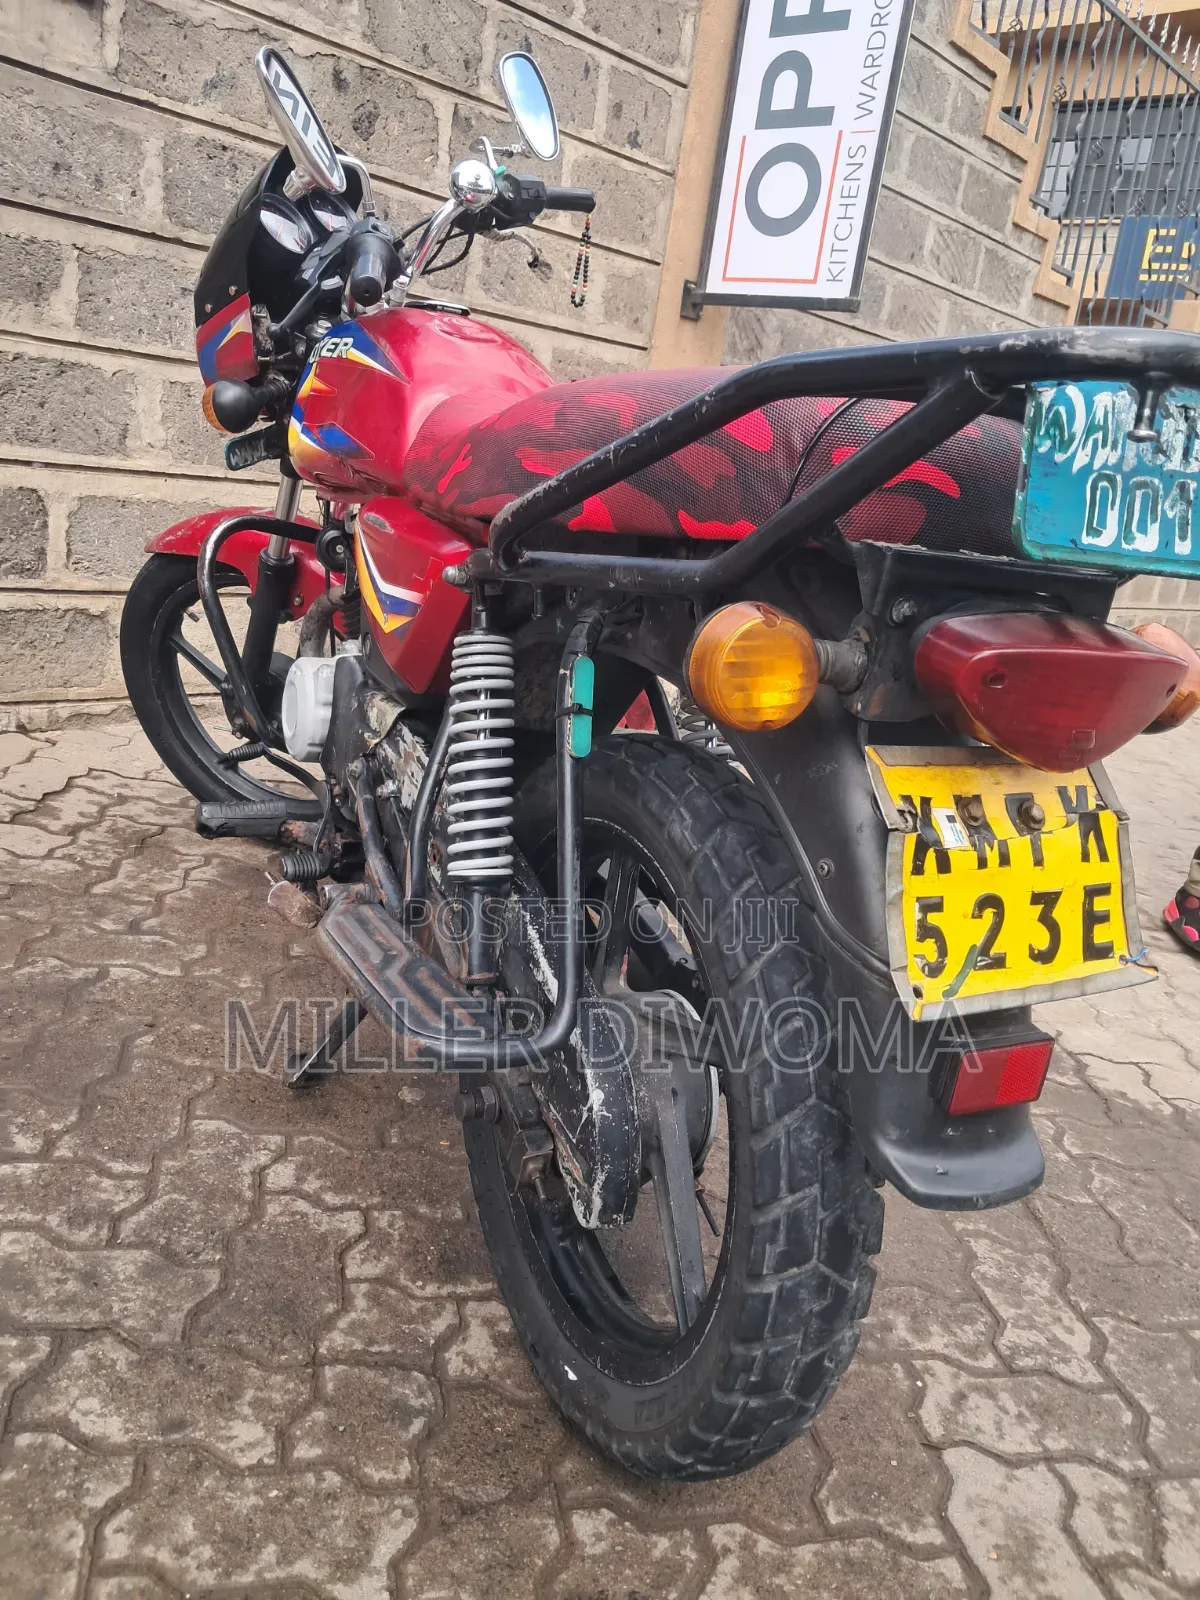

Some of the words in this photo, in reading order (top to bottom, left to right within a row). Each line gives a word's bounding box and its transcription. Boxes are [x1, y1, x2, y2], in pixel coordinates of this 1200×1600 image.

[826, 144, 867, 283] KITCHENS
[1081, 470, 1197, 555] 001
[911, 882, 1115, 978] 523E
